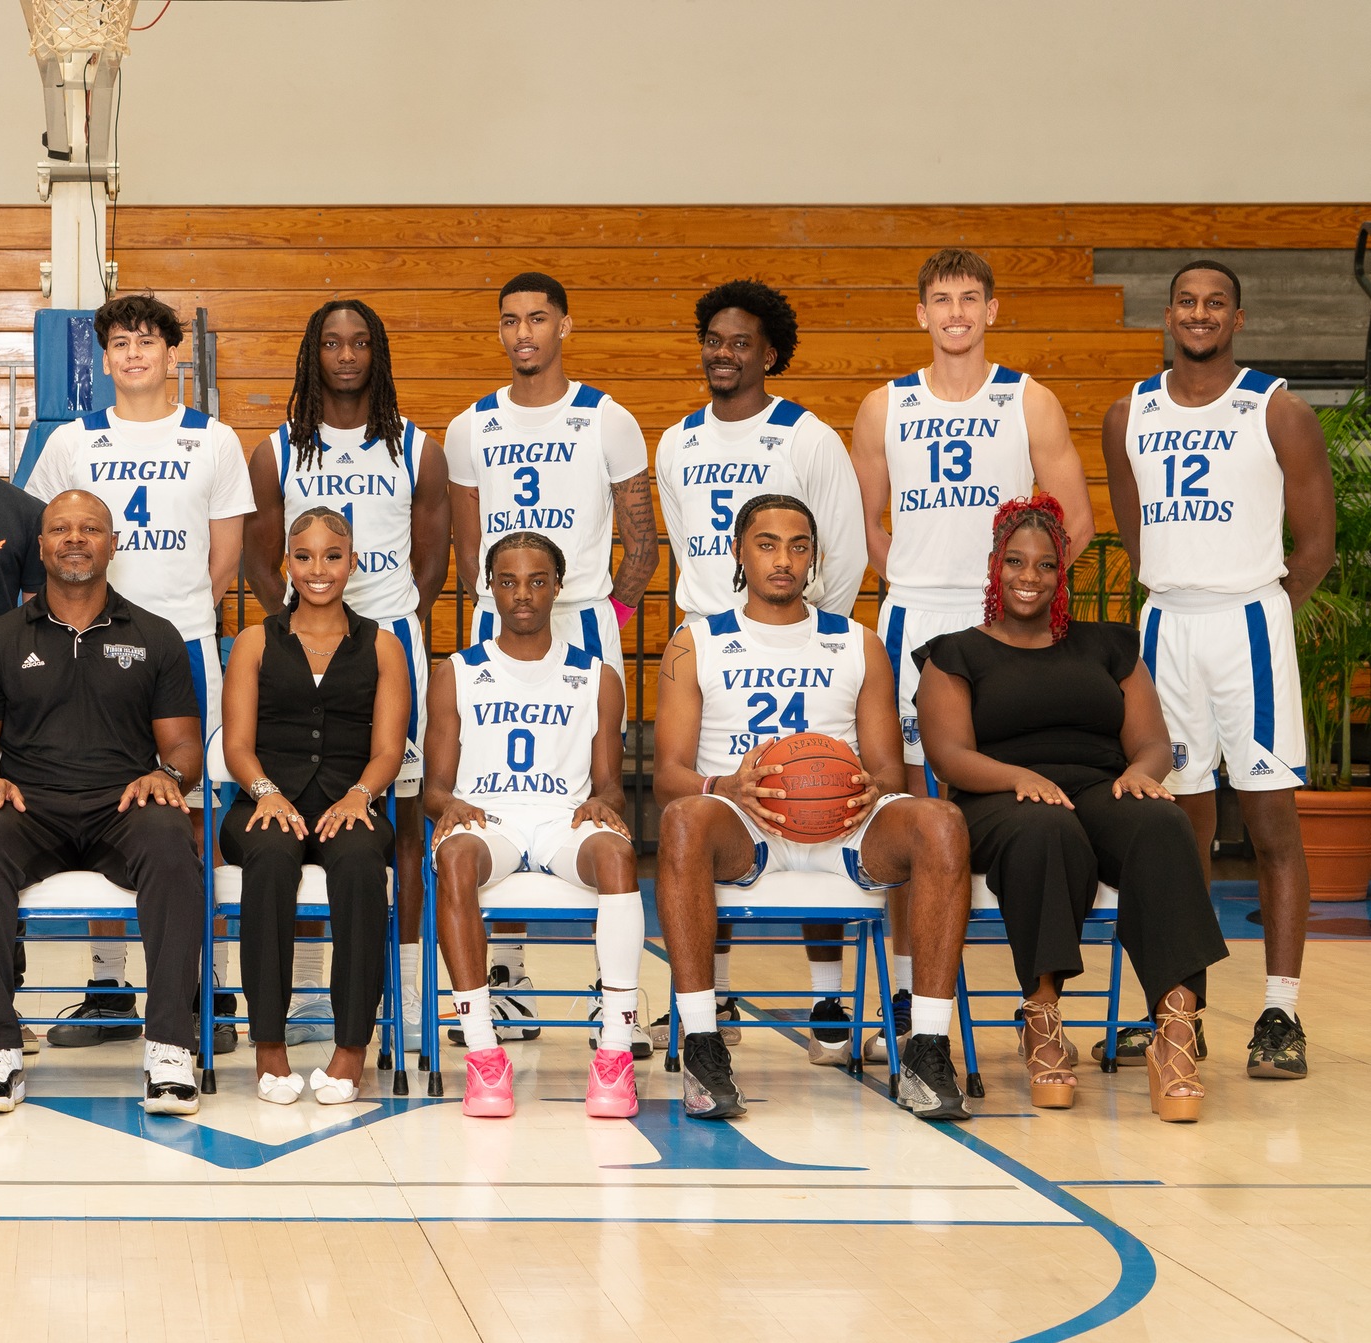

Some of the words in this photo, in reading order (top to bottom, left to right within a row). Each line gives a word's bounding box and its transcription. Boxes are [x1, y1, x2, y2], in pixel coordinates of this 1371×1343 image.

[482, 425, 502, 434] adidas
[899, 418, 1000, 442] VIRGIN
[1138, 429, 1238, 455] VIRGIN
[482, 442, 577, 468] VIRGIN
[927, 440, 972, 483] 13
[89, 460, 191, 482] VIRGIN
[683, 463, 771, 486] VIRGIN
[1162, 454, 1210, 498] 12
[295, 474, 396, 498] VIRGIN
[513, 466, 540, 507] 3
[899, 485, 1000, 512] ISLANDS
[123, 485, 151, 528] 4
[711, 489, 733, 531] 5
[486, 508, 575, 533] ISLANDS
[113, 529, 187, 552] LANDS
[21, 661, 45, 669] adidas
[722, 668, 834, 690] VIRGIN
[473, 701, 574, 726] VIRGIN
[747, 692, 809, 735] 24
[506, 728, 535, 773] 0
[469, 772, 568, 795] ISLANDS
